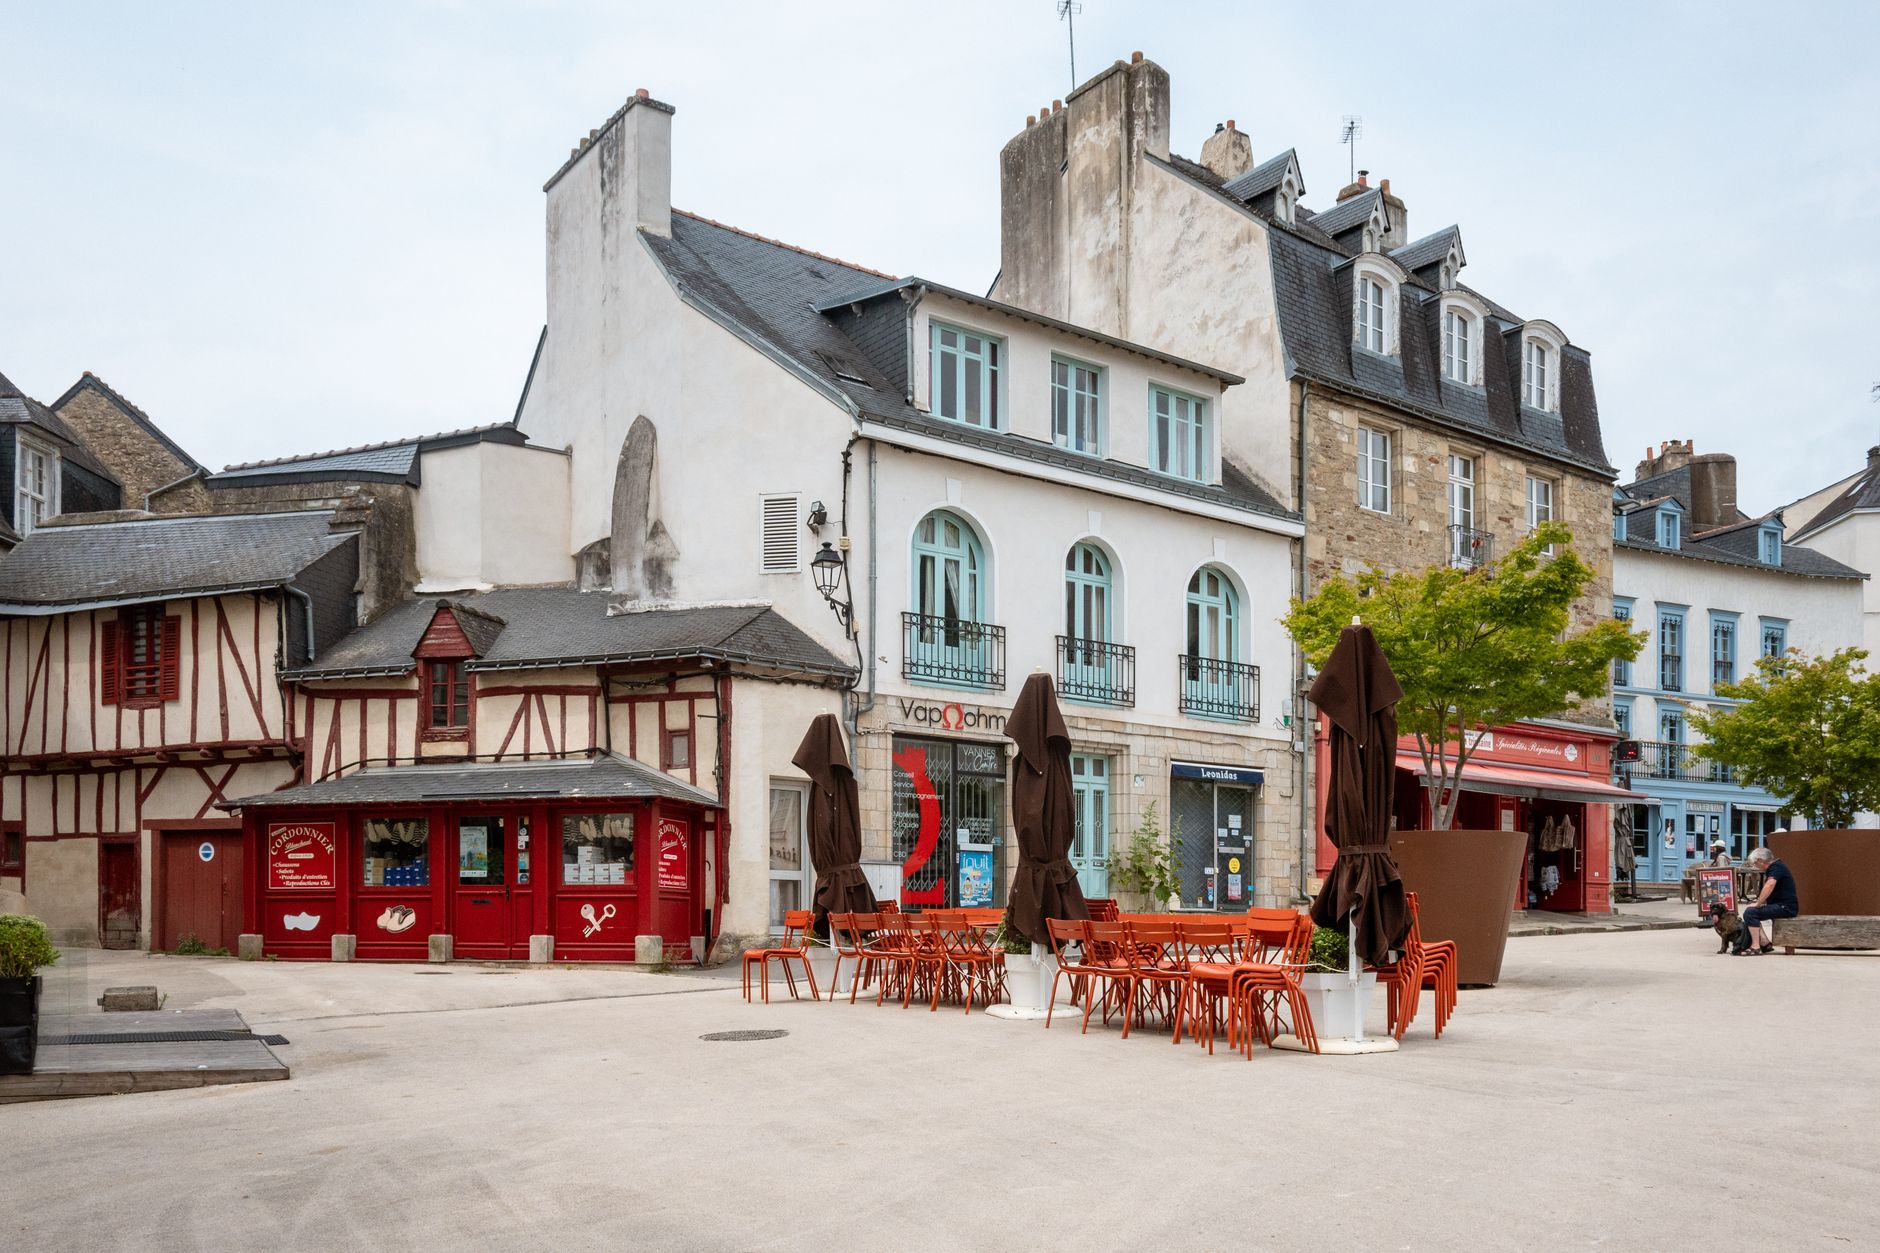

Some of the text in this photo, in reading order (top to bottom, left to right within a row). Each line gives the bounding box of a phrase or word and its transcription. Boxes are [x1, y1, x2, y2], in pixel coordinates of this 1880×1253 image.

[963, 746, 996, 759] VANNES
[893, 770, 915, 779] Conseil
[1200, 768, 1238, 781] Leonidas
[893, 780, 914, 789] Service
[893, 790, 945, 801] Accompagnement
[271, 827, 334, 855] CORDONNIER
[658, 824, 687, 851] RDONNIER
